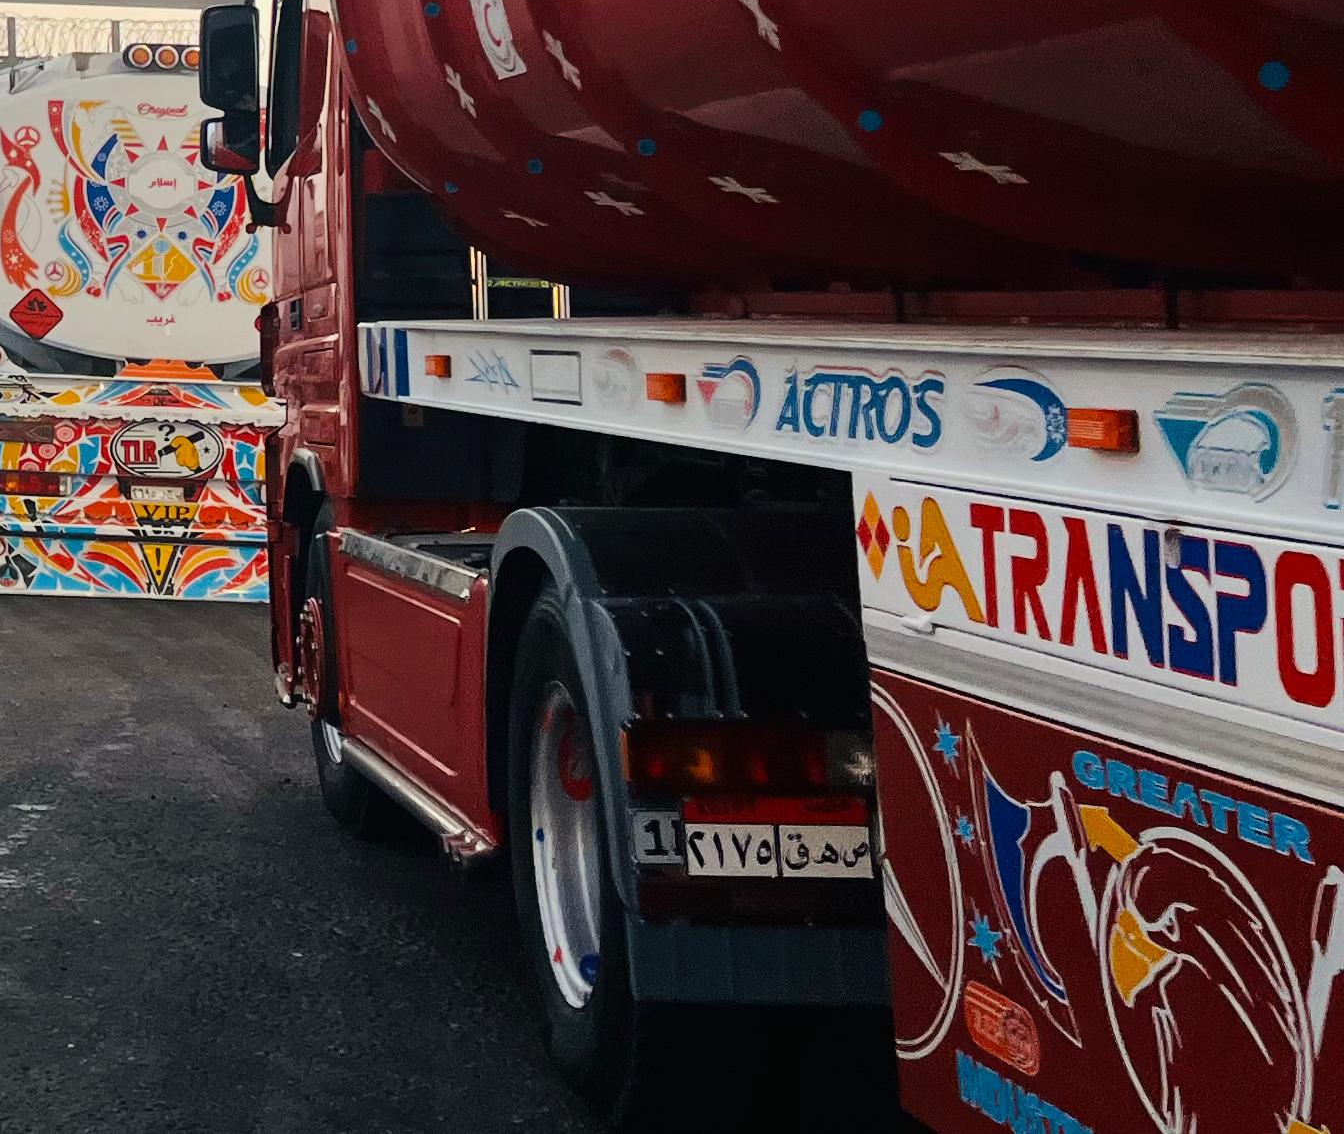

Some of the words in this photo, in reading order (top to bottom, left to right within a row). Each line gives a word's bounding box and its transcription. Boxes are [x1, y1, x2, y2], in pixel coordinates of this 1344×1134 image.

[137, 103, 189, 119] Original
[776, 370, 945, 449] ACTROS
[120, 439, 158, 465] TIR
[142, 504, 190, 520] VIP
[970, 501, 1344, 709] TRANSPO
[1072, 749, 1316, 866] GREATER
[688, 830, 772, 869] ٢١٧٥
